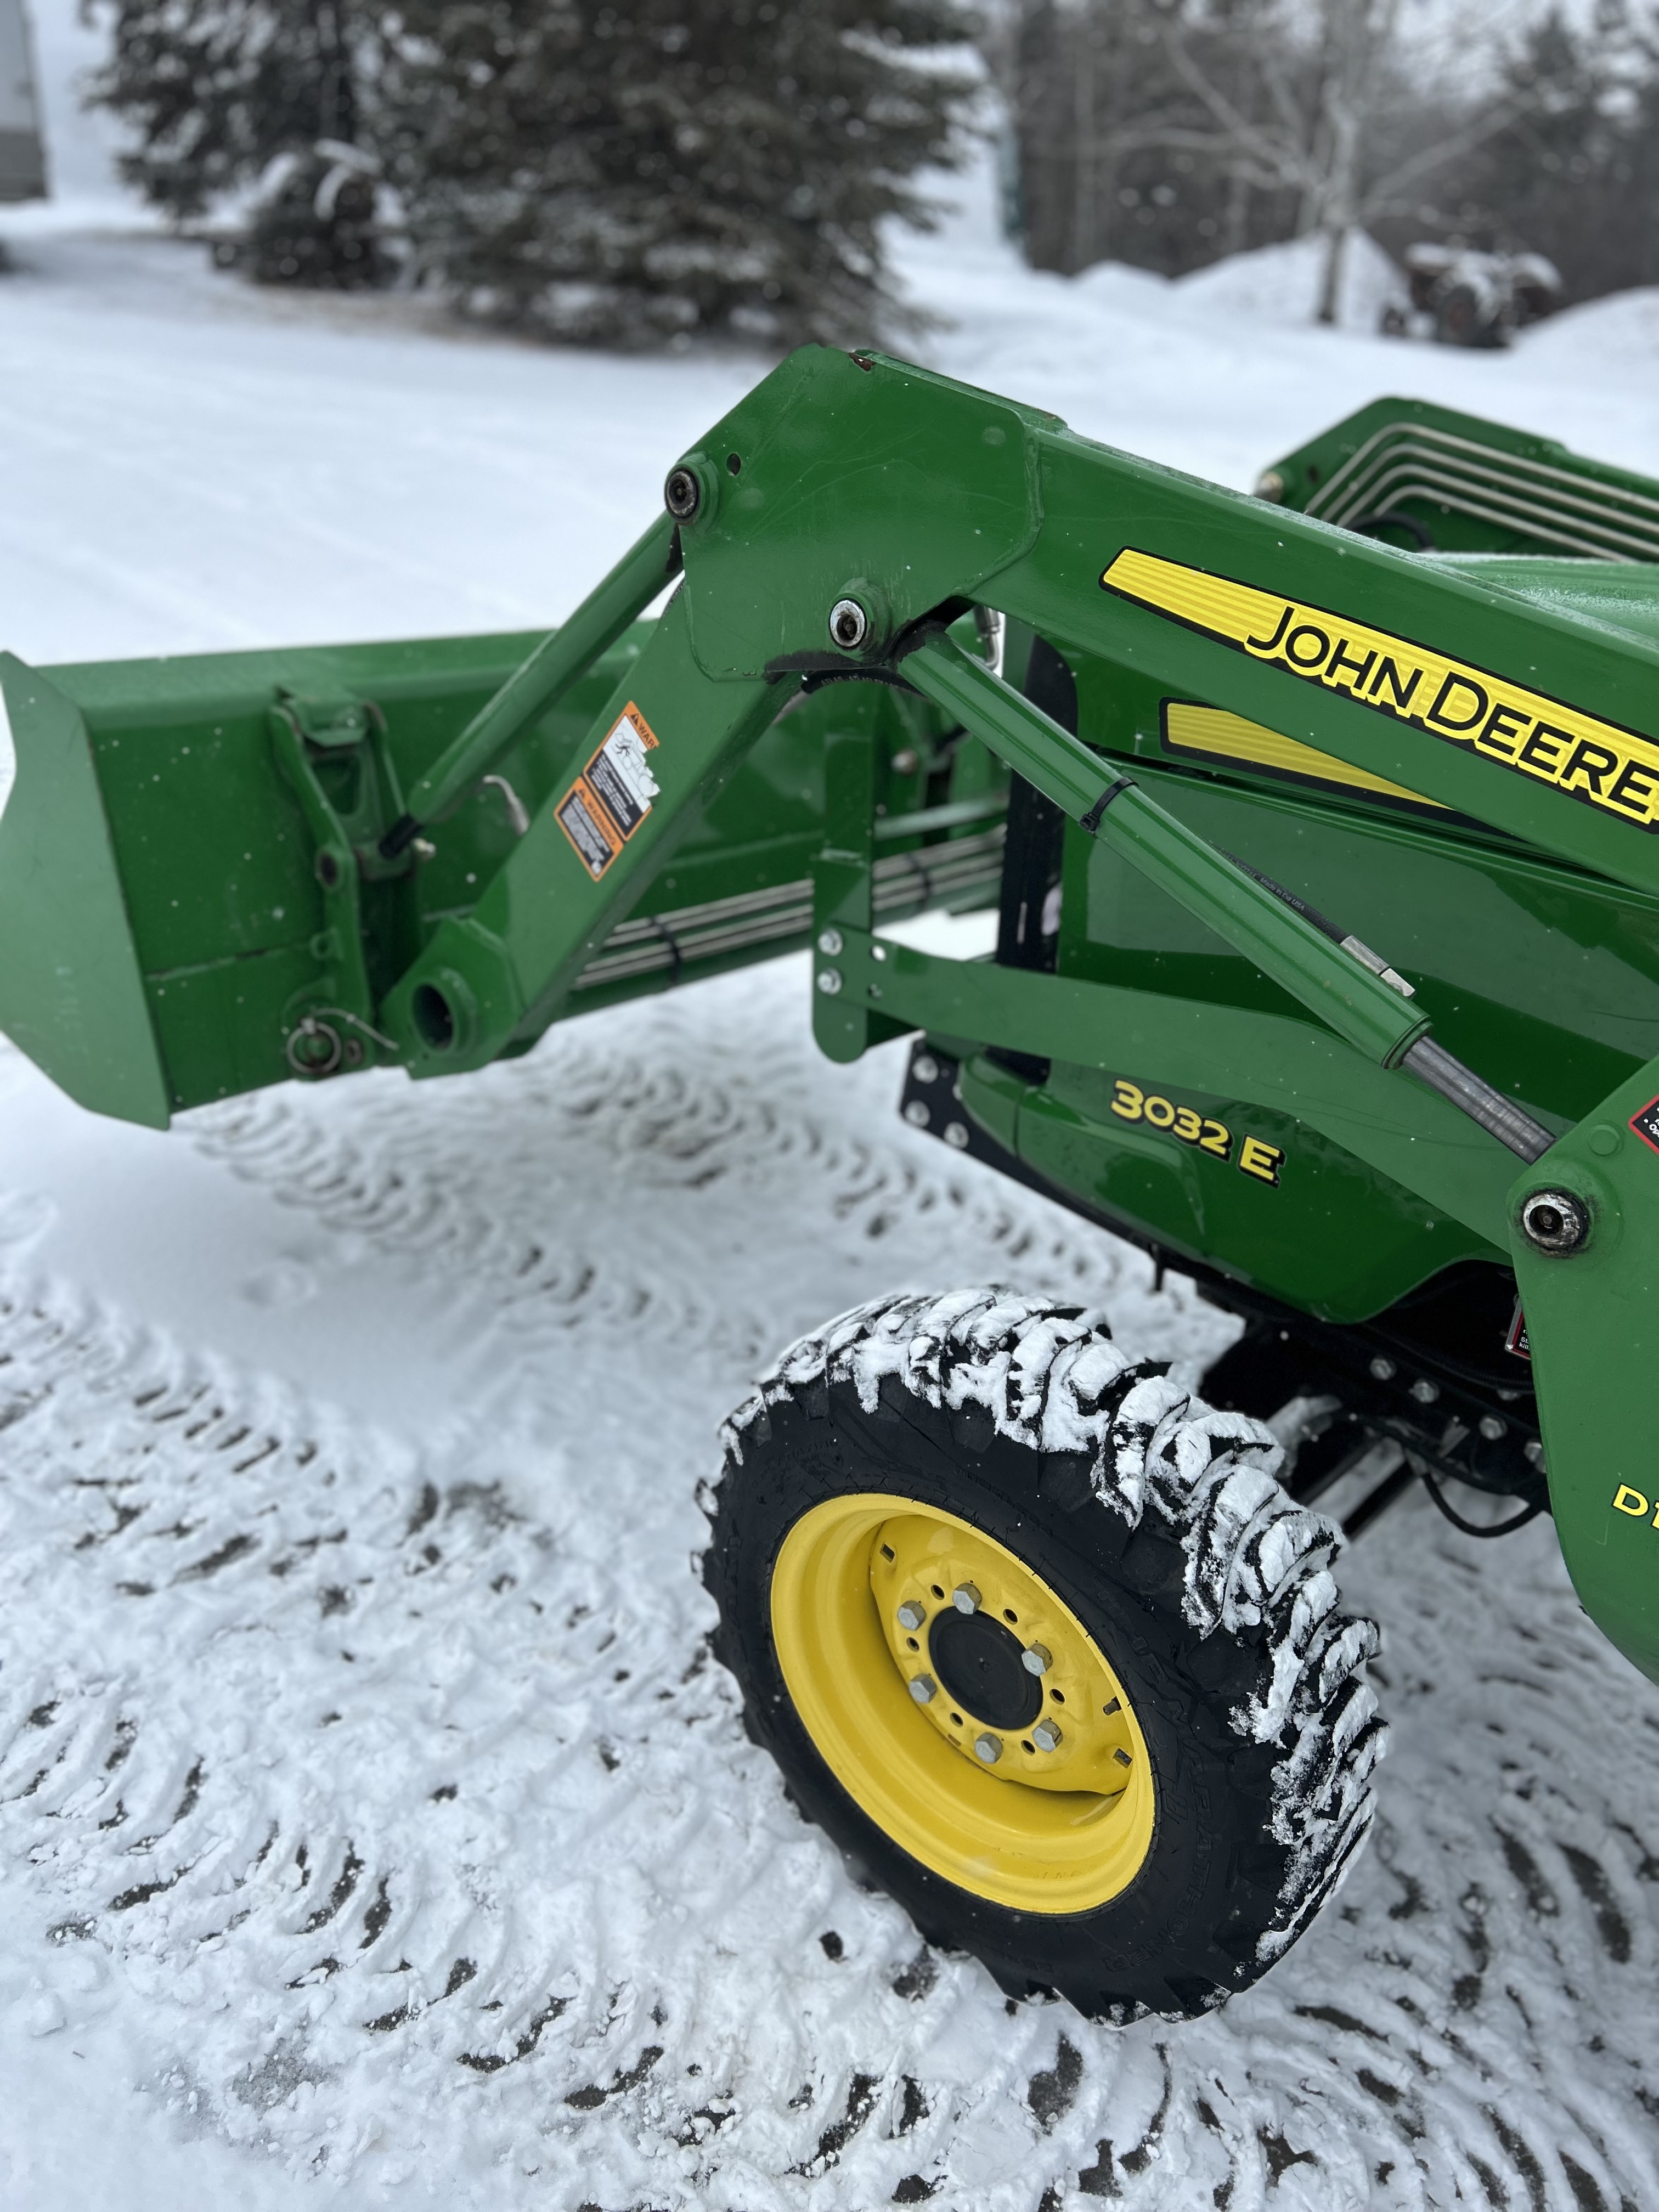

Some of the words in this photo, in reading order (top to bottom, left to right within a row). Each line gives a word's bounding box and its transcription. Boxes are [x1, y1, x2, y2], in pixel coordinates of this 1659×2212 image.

[1245, 606, 1423, 710] JOHN
[1427, 672, 1659, 815] DEERE
[1291, 899, 1306, 911] USA
[1110, 1079, 1231, 1159] 3032
[1239, 1135, 1283, 1184] E
